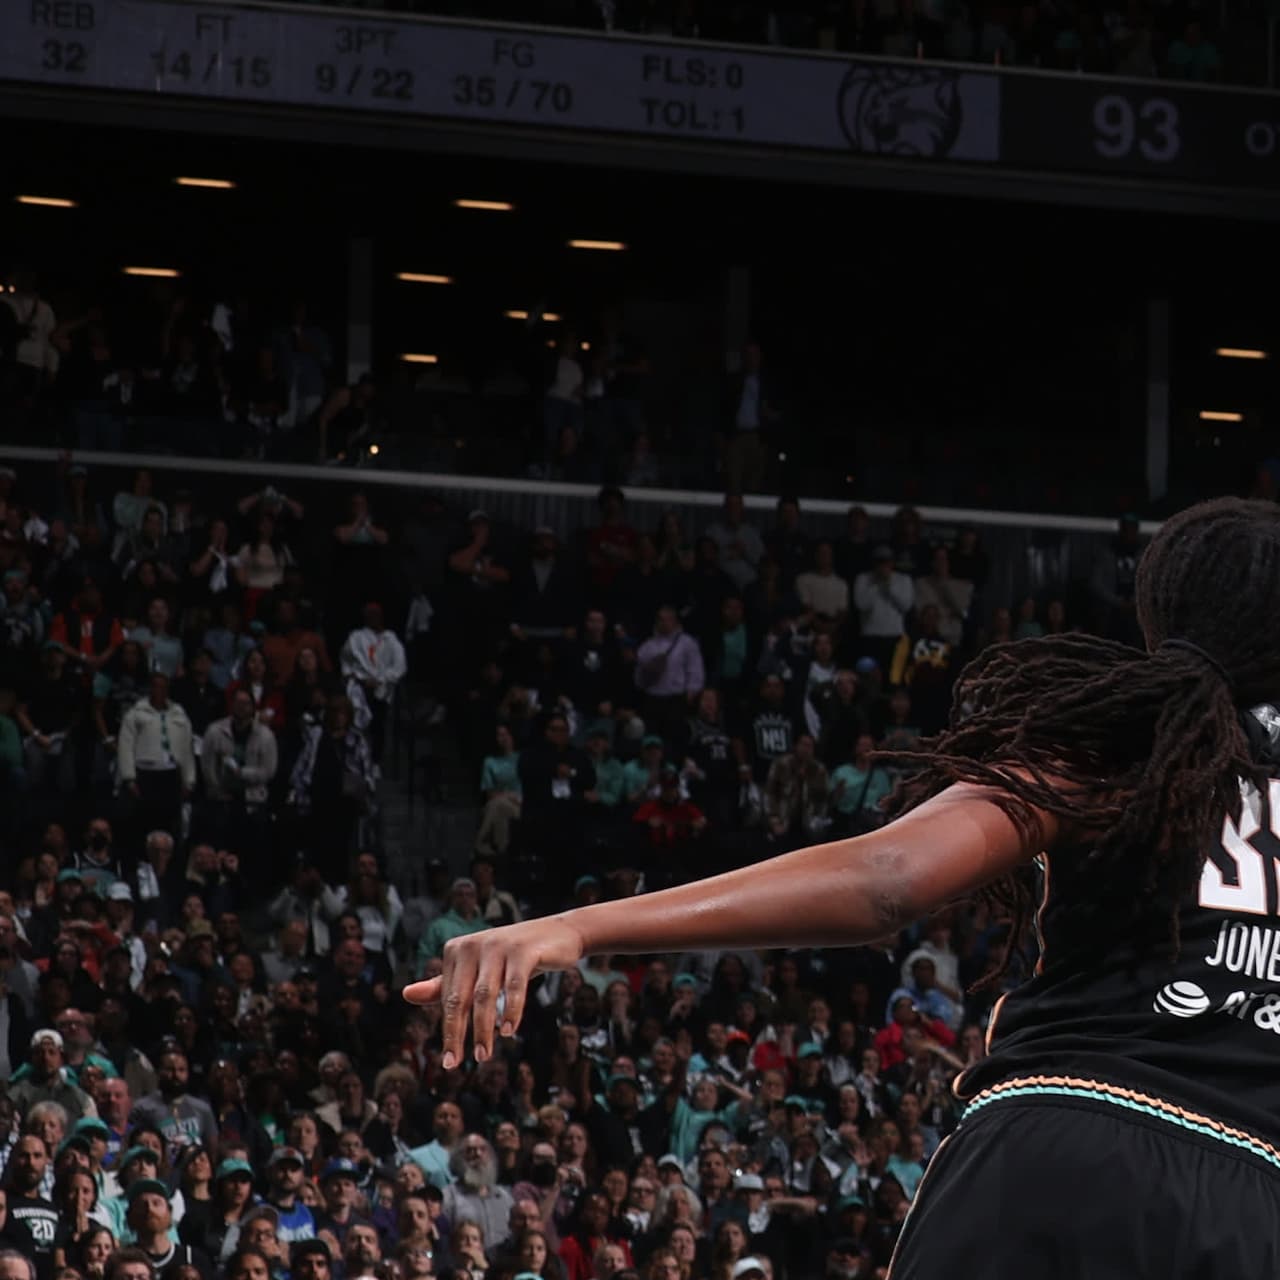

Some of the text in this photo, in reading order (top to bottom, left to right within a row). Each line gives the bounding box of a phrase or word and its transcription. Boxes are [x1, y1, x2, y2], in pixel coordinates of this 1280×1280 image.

[31, 1, 95, 30] REB
[196, 14, 236, 41] FT
[336, 27, 398, 56] 3PT
[493, 39, 535, 68] FG
[42, 40, 87, 73] 32
[1092, 95, 1181, 161] 93
